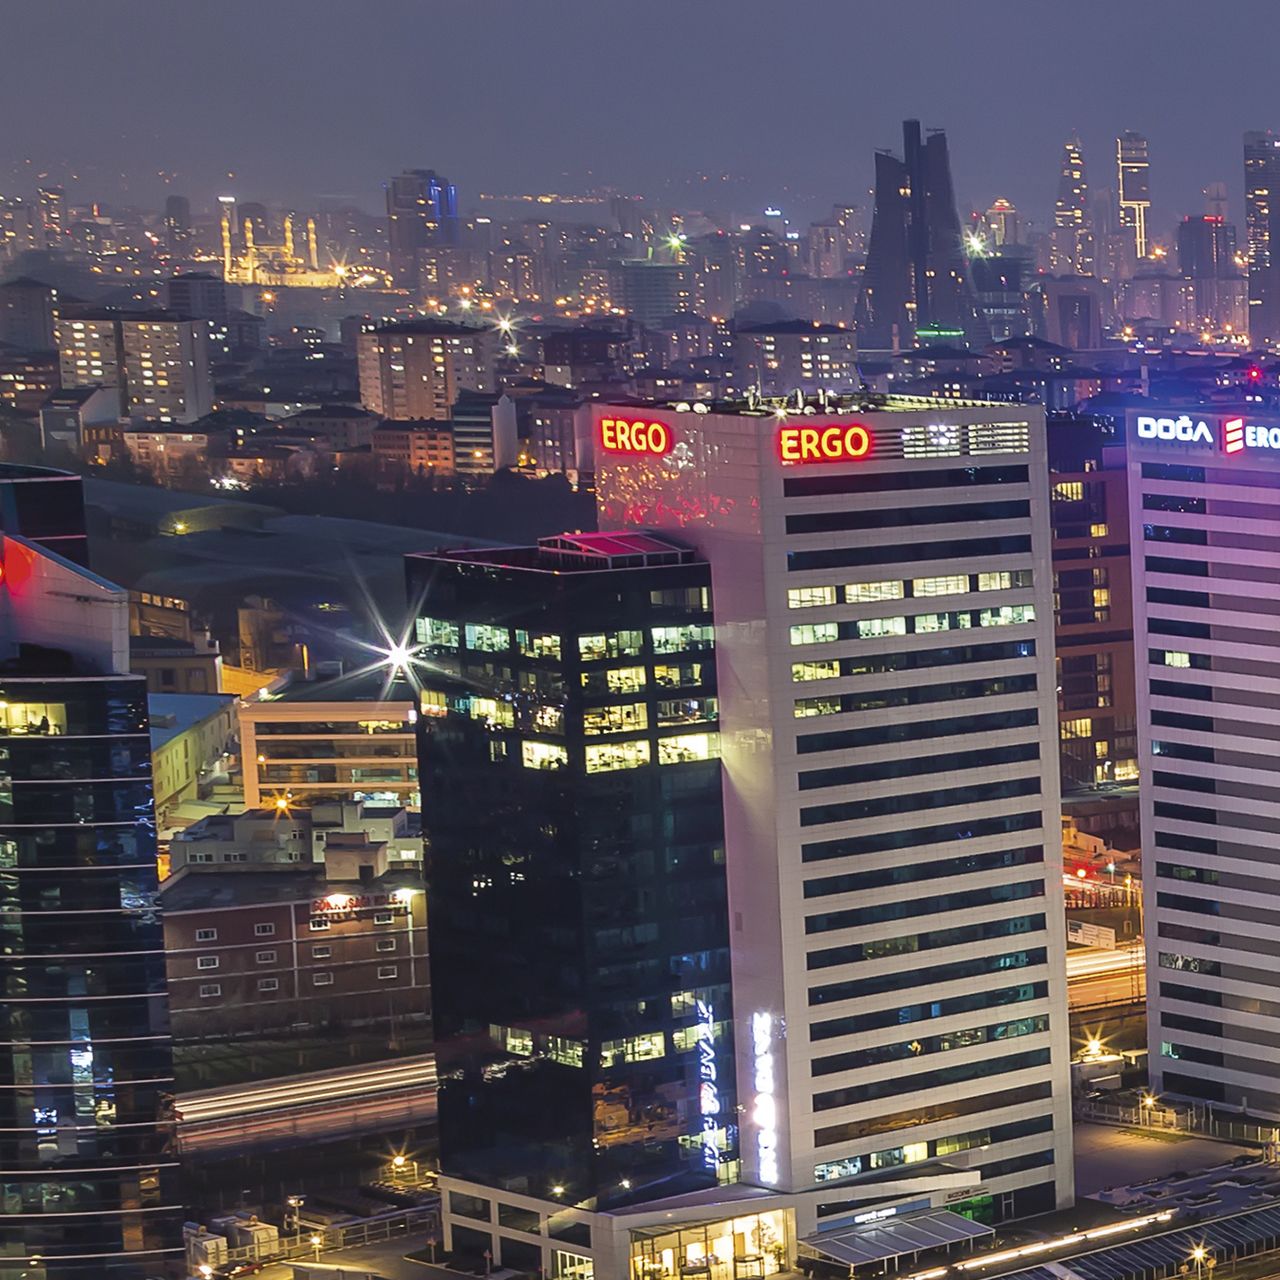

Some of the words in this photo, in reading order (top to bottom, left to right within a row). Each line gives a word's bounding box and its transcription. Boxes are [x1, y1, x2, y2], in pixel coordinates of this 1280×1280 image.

[601, 419, 667, 453] ERGO
[780, 426, 870, 460] ERGO
[1137, 416, 1214, 443] DOĞA
